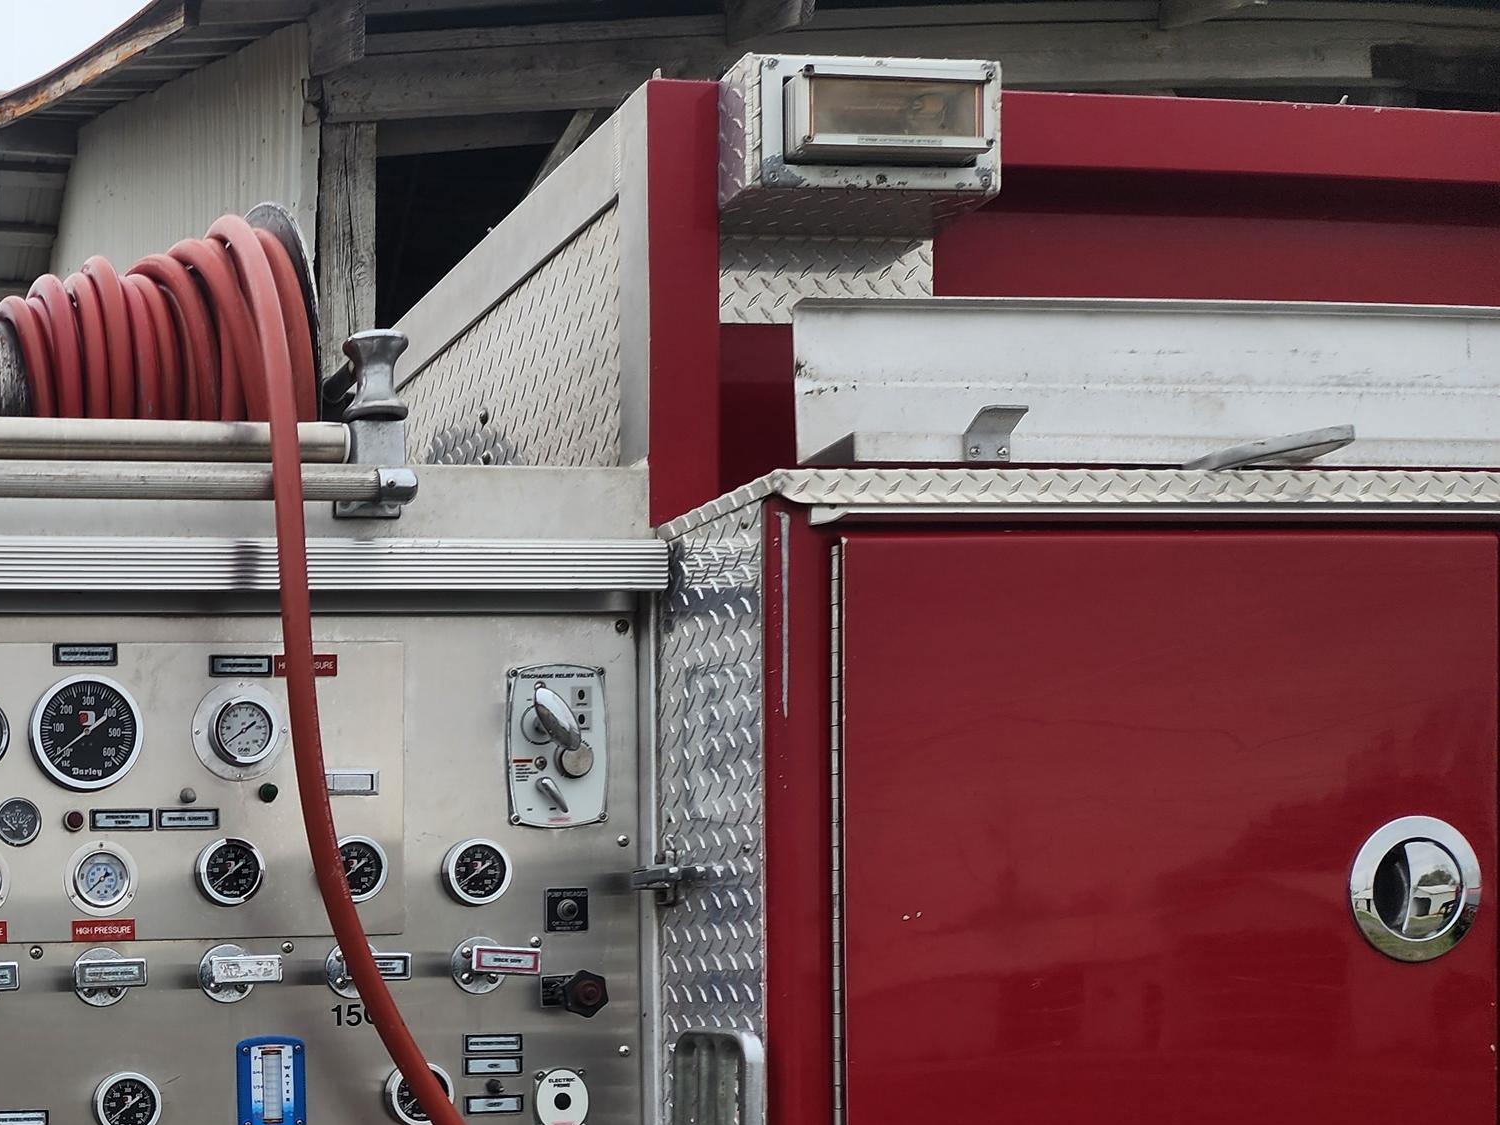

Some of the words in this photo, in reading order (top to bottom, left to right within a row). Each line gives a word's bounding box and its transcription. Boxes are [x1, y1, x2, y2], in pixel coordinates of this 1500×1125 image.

[82, 697, 95, 705] 300
[60, 705, 72, 714] 200
[104, 708, 116, 717] 400
[53, 723, 64, 732] 100
[108, 728, 121, 737] 500
[103, 747, 115, 756] 600
[72, 768, 102, 776] Darley
[75, 927, 92, 935] HIGH
[94, 926, 131, 934] PRESSURE
